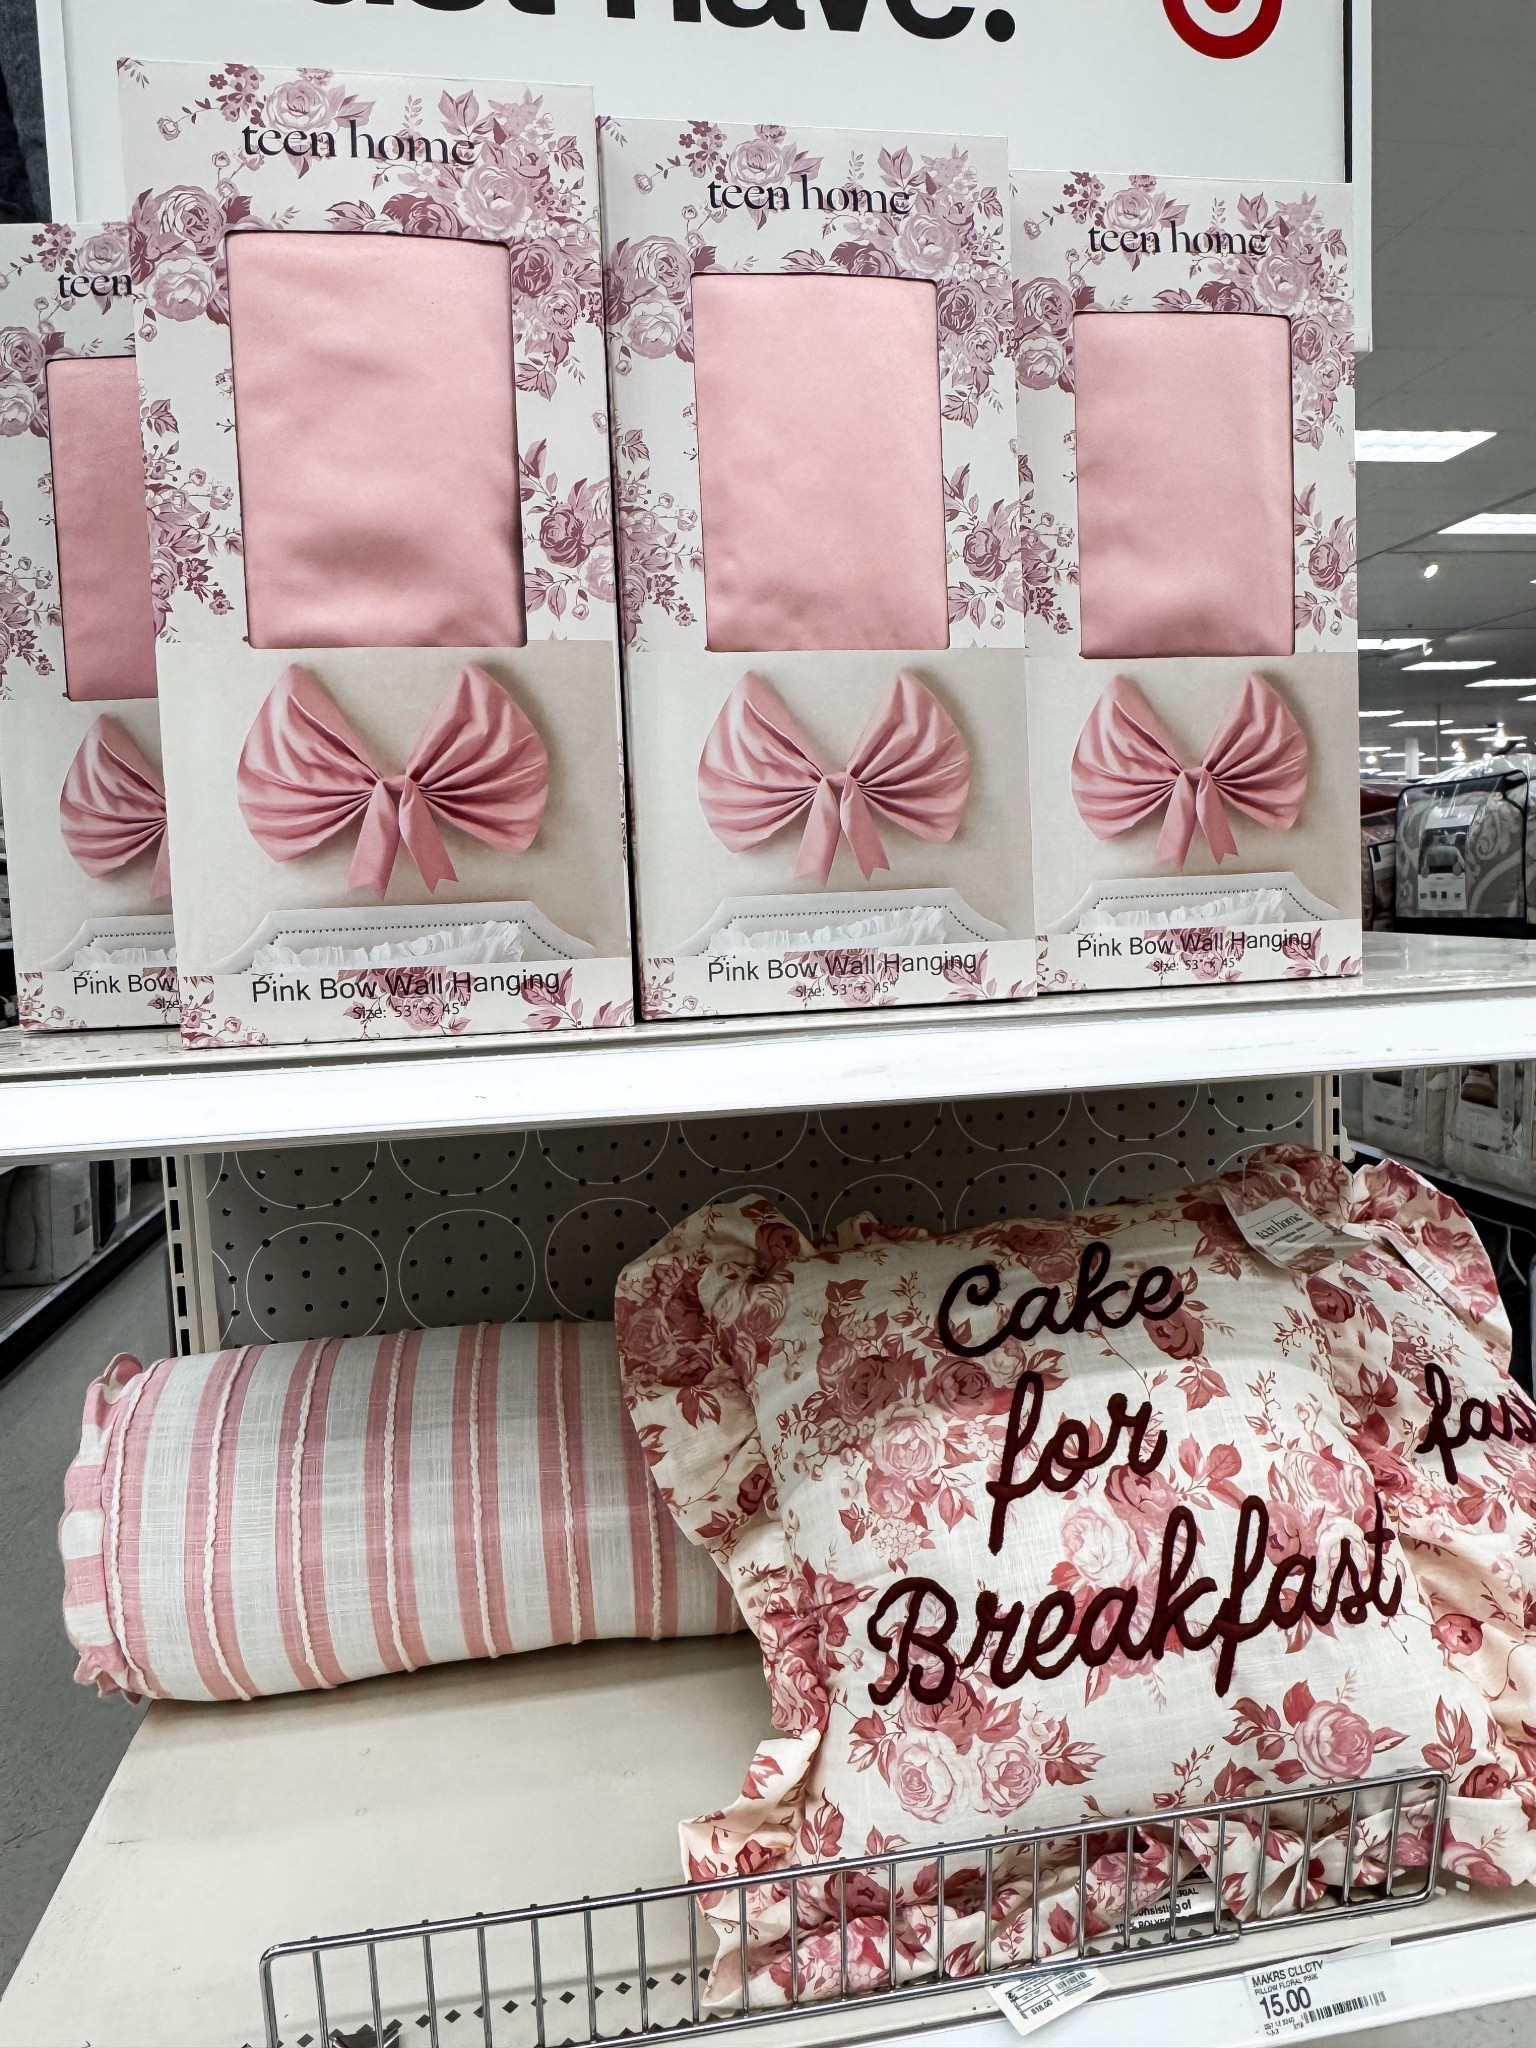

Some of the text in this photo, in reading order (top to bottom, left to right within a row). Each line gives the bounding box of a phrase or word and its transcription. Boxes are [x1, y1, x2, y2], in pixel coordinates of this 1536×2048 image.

[241, 119, 480, 166] teen home
[706, 173, 914, 215] teen home
[1087, 220, 1271, 255] teen home
[57, 273, 133, 299] teen
[1077, 928, 1312, 958] Pink Bow Wall Hanging
[74, 973, 175, 995] Pink Bow
[708, 950, 977, 983] Pink Bow Wall Hanging
[252, 968, 560, 1003] Pink Bow Wall Hanging
[937, 1240, 1186, 1359] Cake
[985, 1370, 1169, 1556] for
[866, 1491, 1404, 1706] Breakfast
[1251, 1969, 1287, 1988] MAKRS
[1259, 1986, 1312, 2020] 15.00
